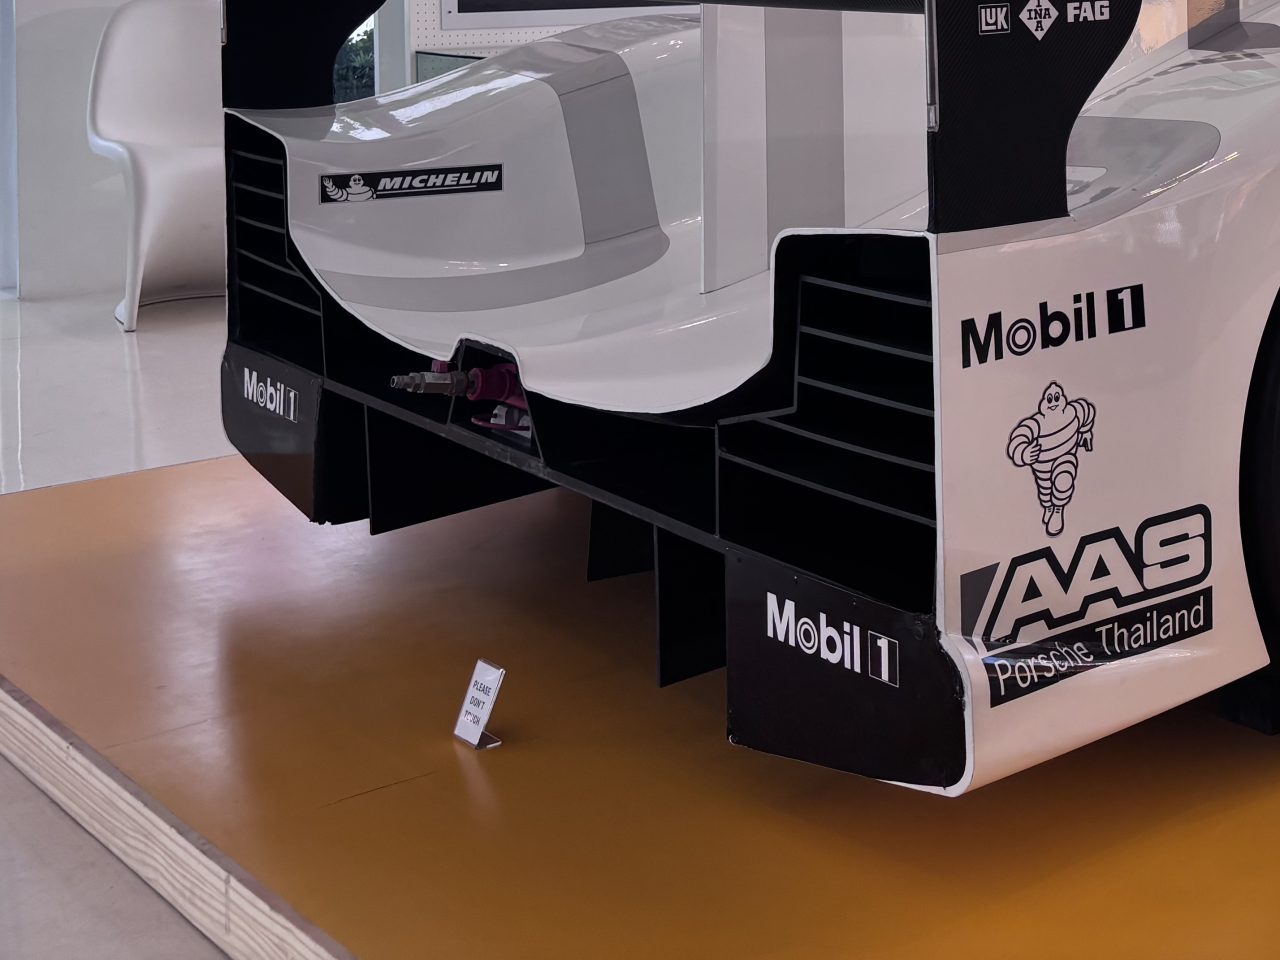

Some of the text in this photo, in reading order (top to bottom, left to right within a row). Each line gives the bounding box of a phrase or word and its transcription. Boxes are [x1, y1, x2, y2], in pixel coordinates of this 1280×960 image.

[1066, 0, 1110, 23] FAG
[377, 170, 499, 190] MICHELIN
[961, 291, 1096, 369] Mobil
[244, 367, 285, 416] Mobil
[984, 504, 1212, 642] AAS
[766, 591, 890, 683] Mobil 1
[993, 594, 1205, 696] Porsche Thailand
[469, 695, 486, 710] DON'T
[472, 679, 492, 697] PLEASE
[464, 709, 481, 726] TOUCH
